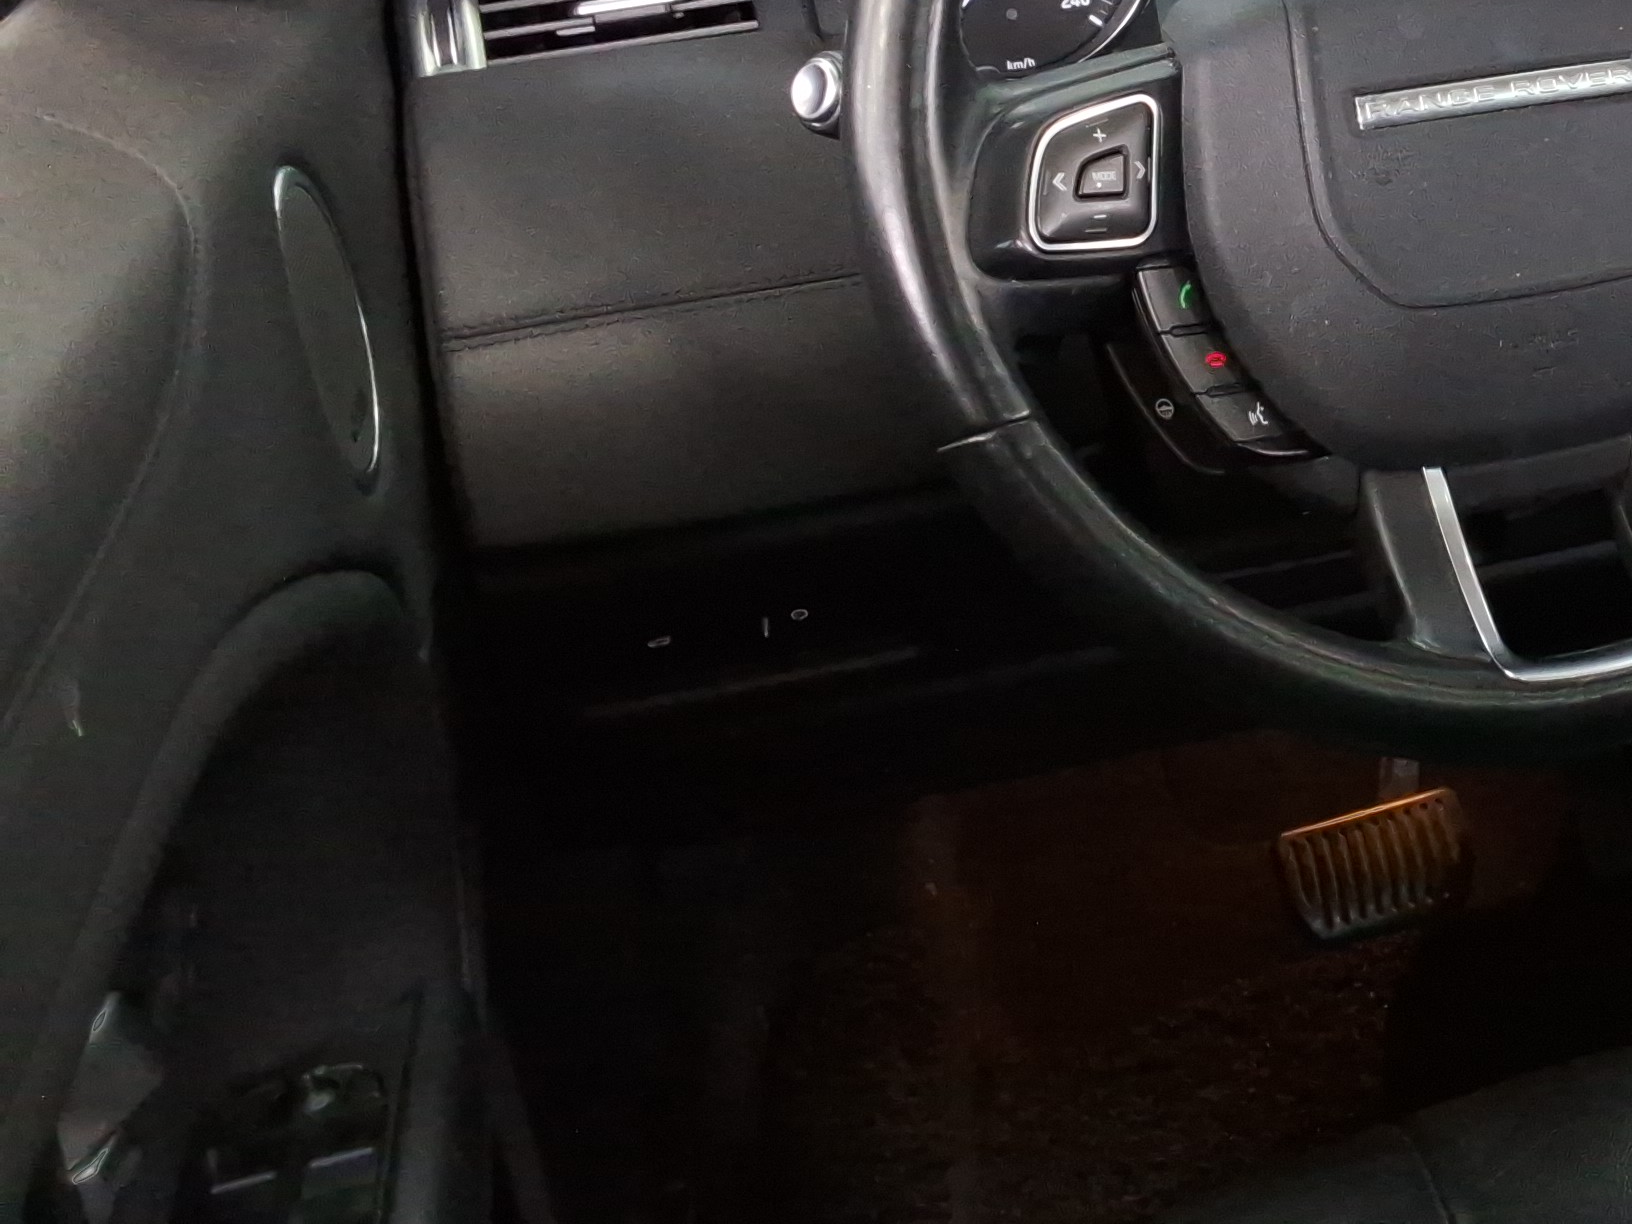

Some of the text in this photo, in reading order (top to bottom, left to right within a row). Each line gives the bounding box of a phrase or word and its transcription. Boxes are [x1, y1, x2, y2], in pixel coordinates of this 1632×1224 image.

[1006, 57, 1036, 71] km/h
[1364, 69, 1632, 122] RANGE ROVER
